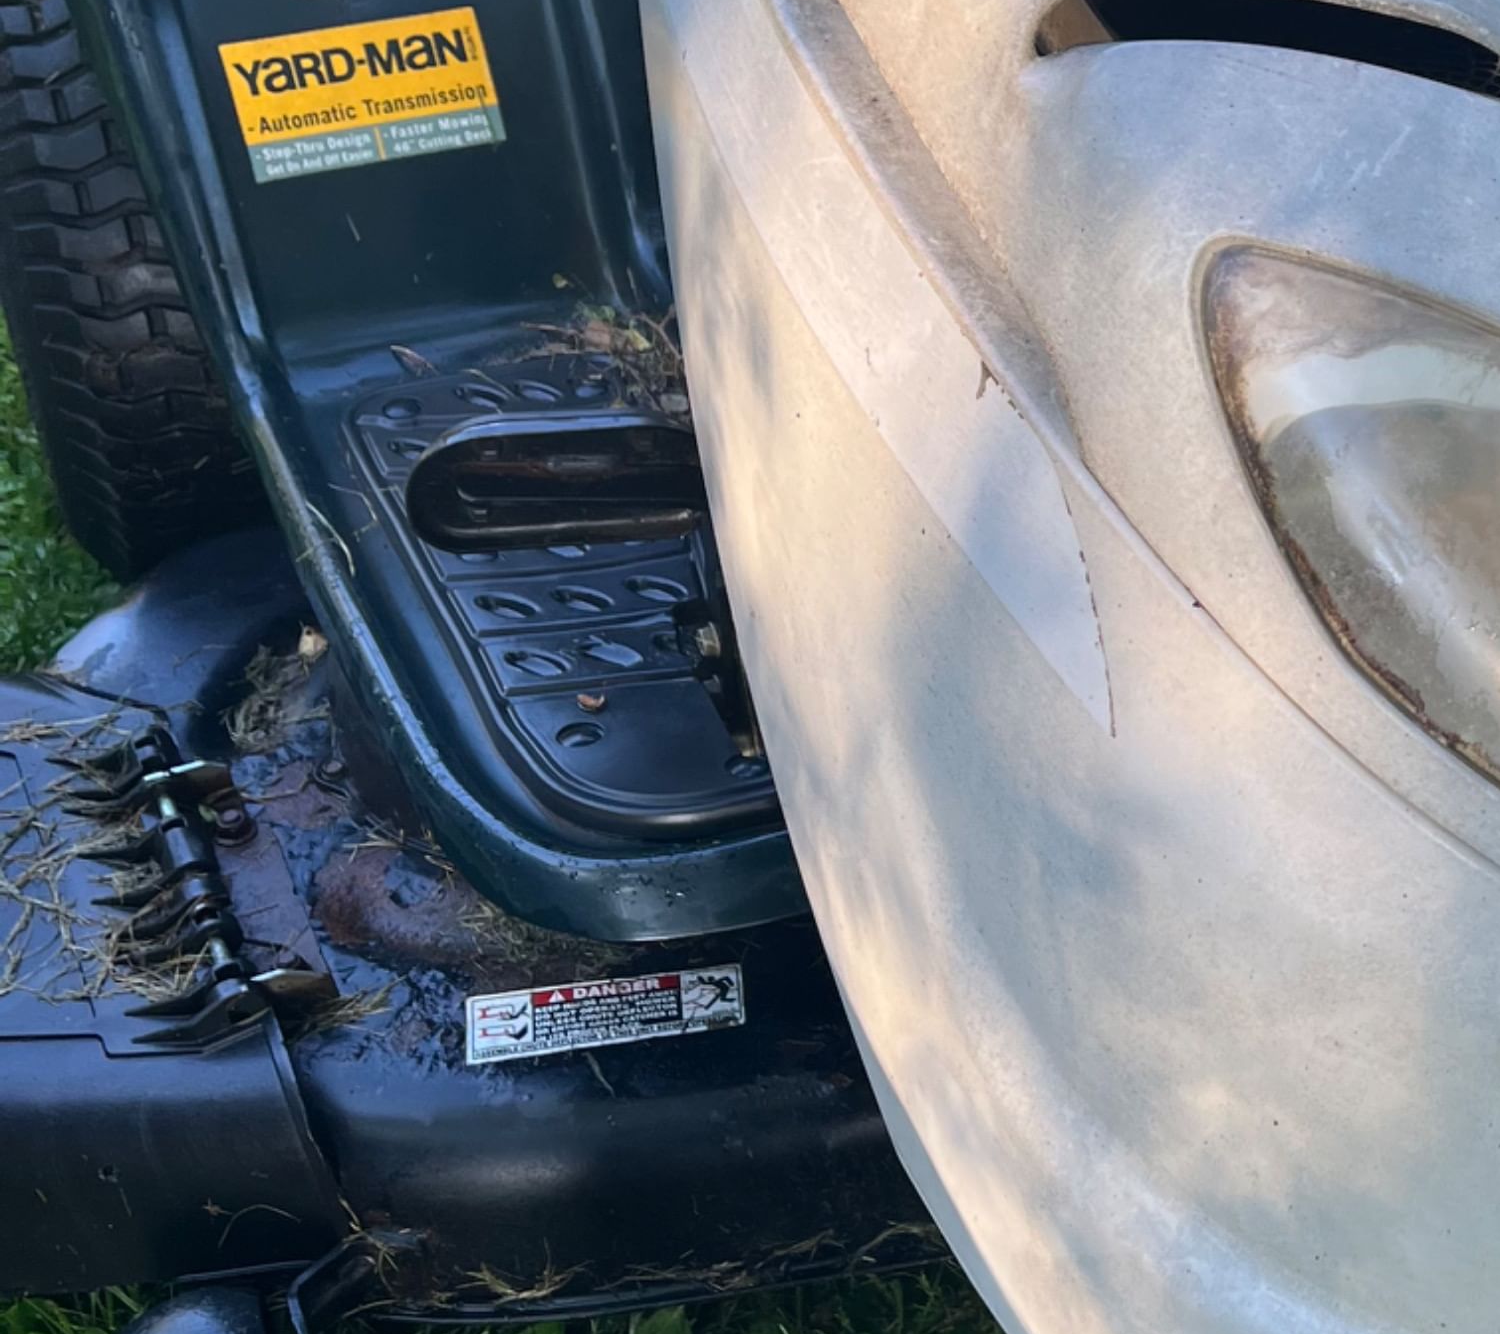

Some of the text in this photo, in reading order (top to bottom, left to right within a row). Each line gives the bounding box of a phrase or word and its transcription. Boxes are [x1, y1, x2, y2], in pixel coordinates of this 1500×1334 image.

[260, 83, 488, 135] Automatic Transmission
[325, 130, 372, 151] Design
[573, 978, 660, 999] DANGER
